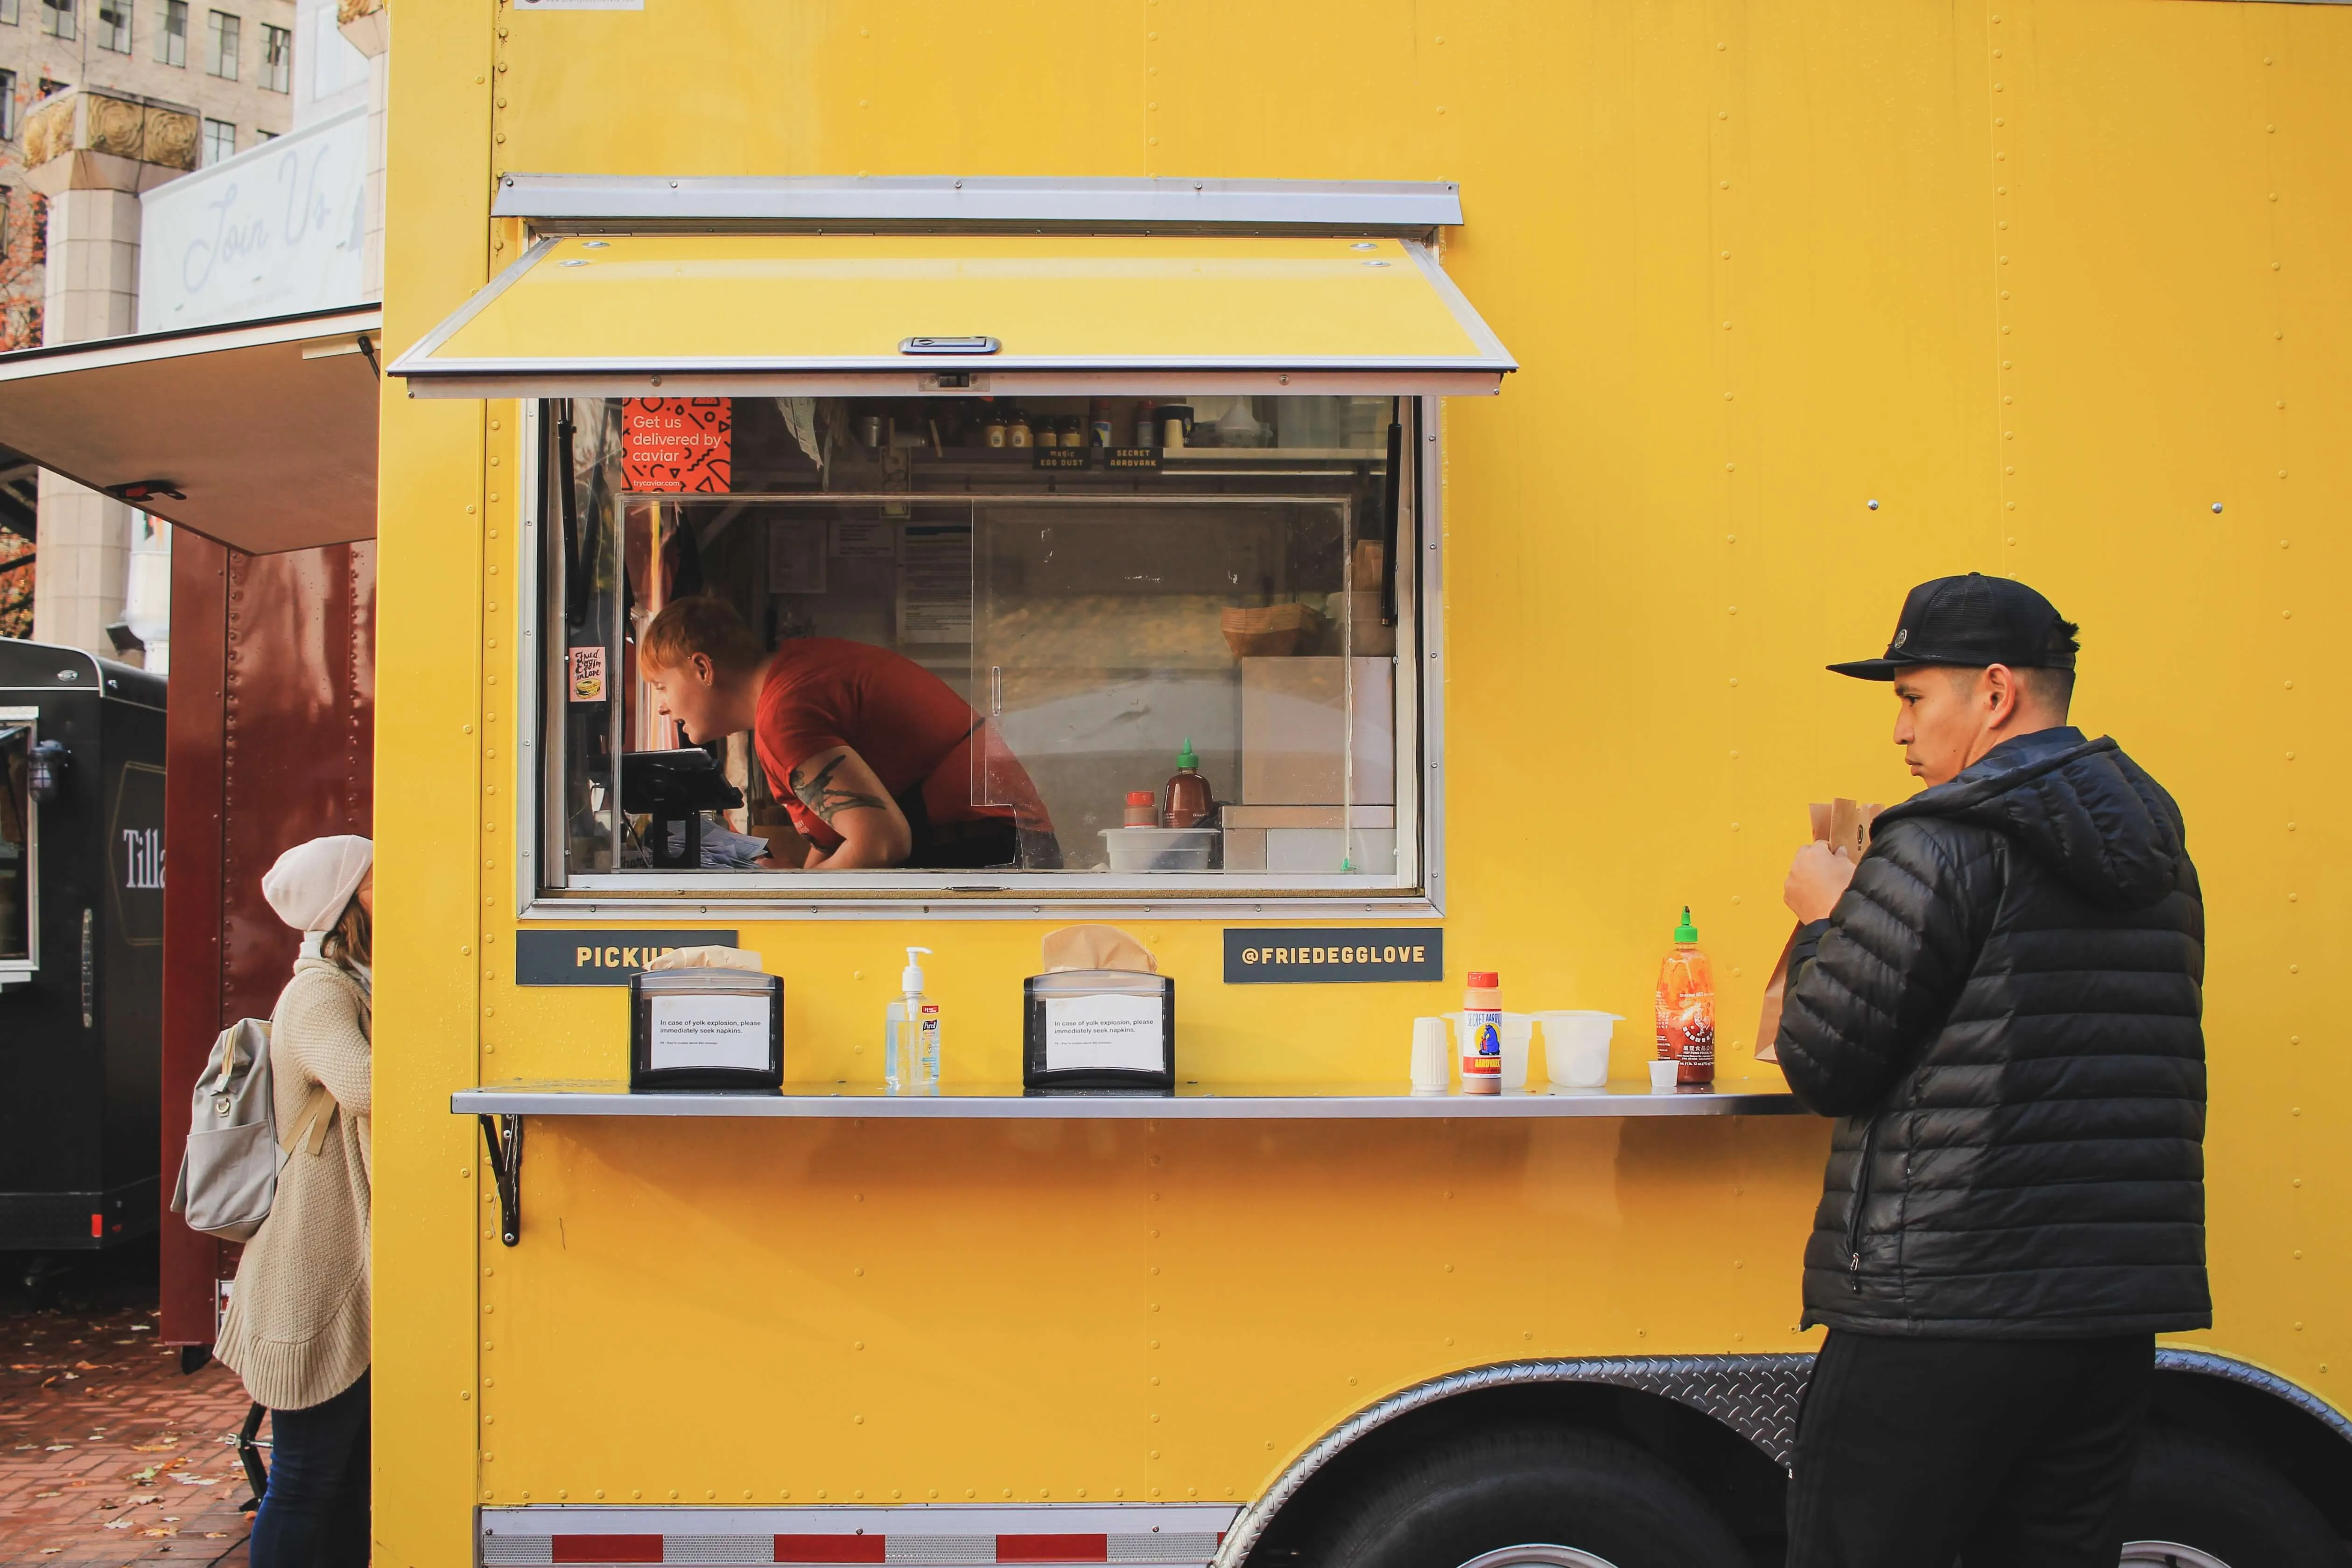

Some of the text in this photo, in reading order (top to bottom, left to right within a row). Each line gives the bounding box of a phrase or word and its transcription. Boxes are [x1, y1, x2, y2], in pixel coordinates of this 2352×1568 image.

[183, 143, 330, 295] Join Us
[633, 415, 681, 428] Get us
[632, 433, 721, 448] delivered by
[632, 450, 680, 462] caviar
[576, 648, 600, 662] Fried
[1242, 946, 1425, 965] @FRIEDEGGLOVE
[1467, 1013, 1485, 1027] SECRET
